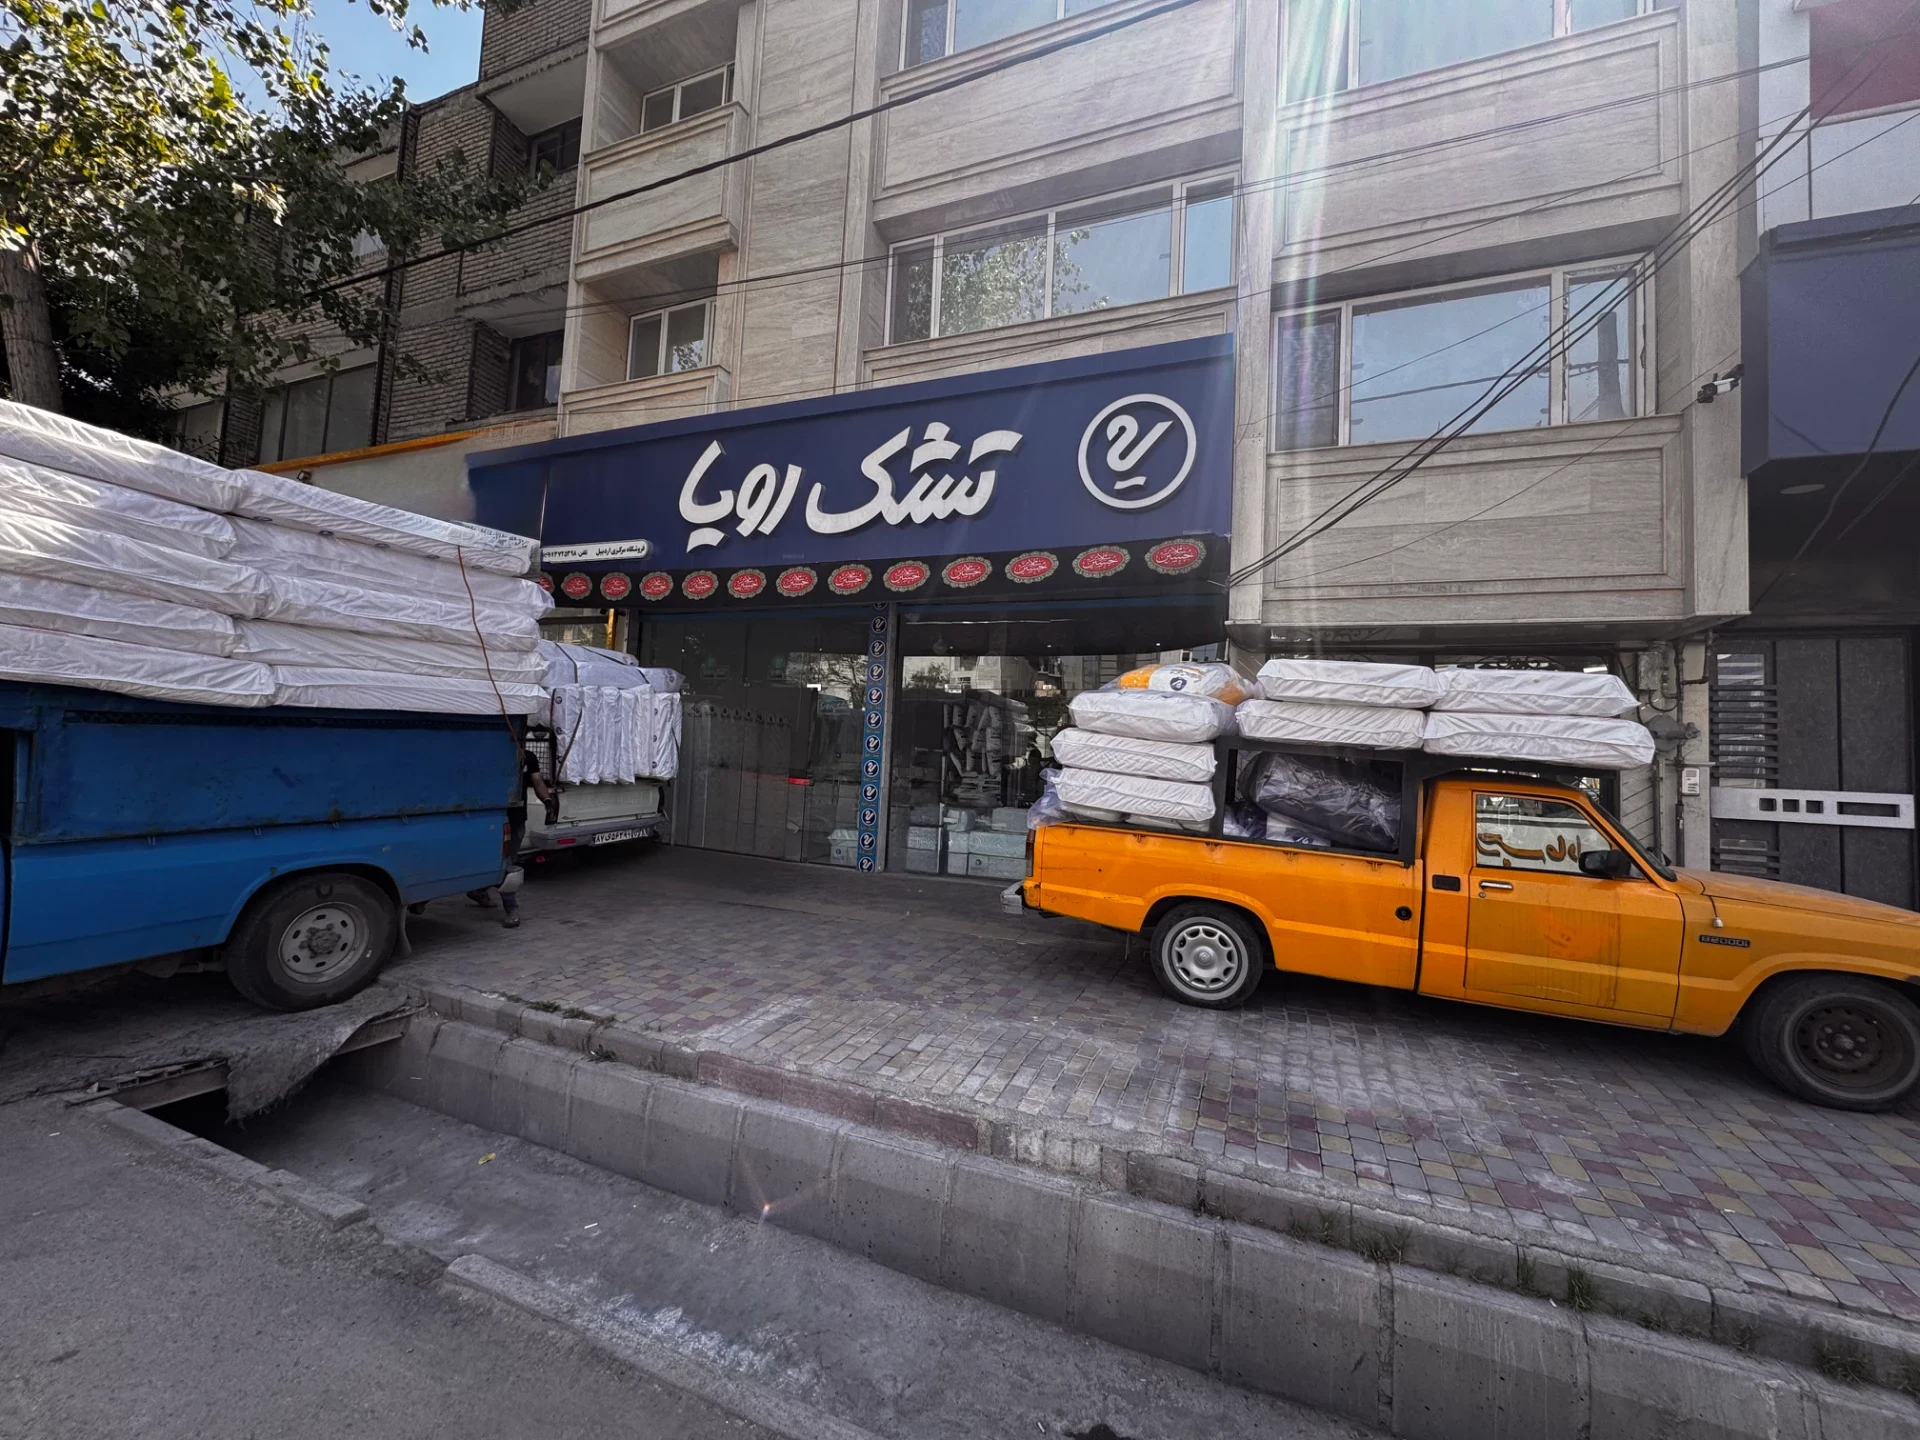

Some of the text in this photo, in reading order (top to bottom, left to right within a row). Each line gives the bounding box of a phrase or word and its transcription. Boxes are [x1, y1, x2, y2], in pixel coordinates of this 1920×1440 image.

[678, 421, 1024, 553] تشک رویا
[595, 547, 611, 556] اردبیل
[611, 546, 626, 555] مرکزی
[626, 545, 645, 554] فروشگاه
